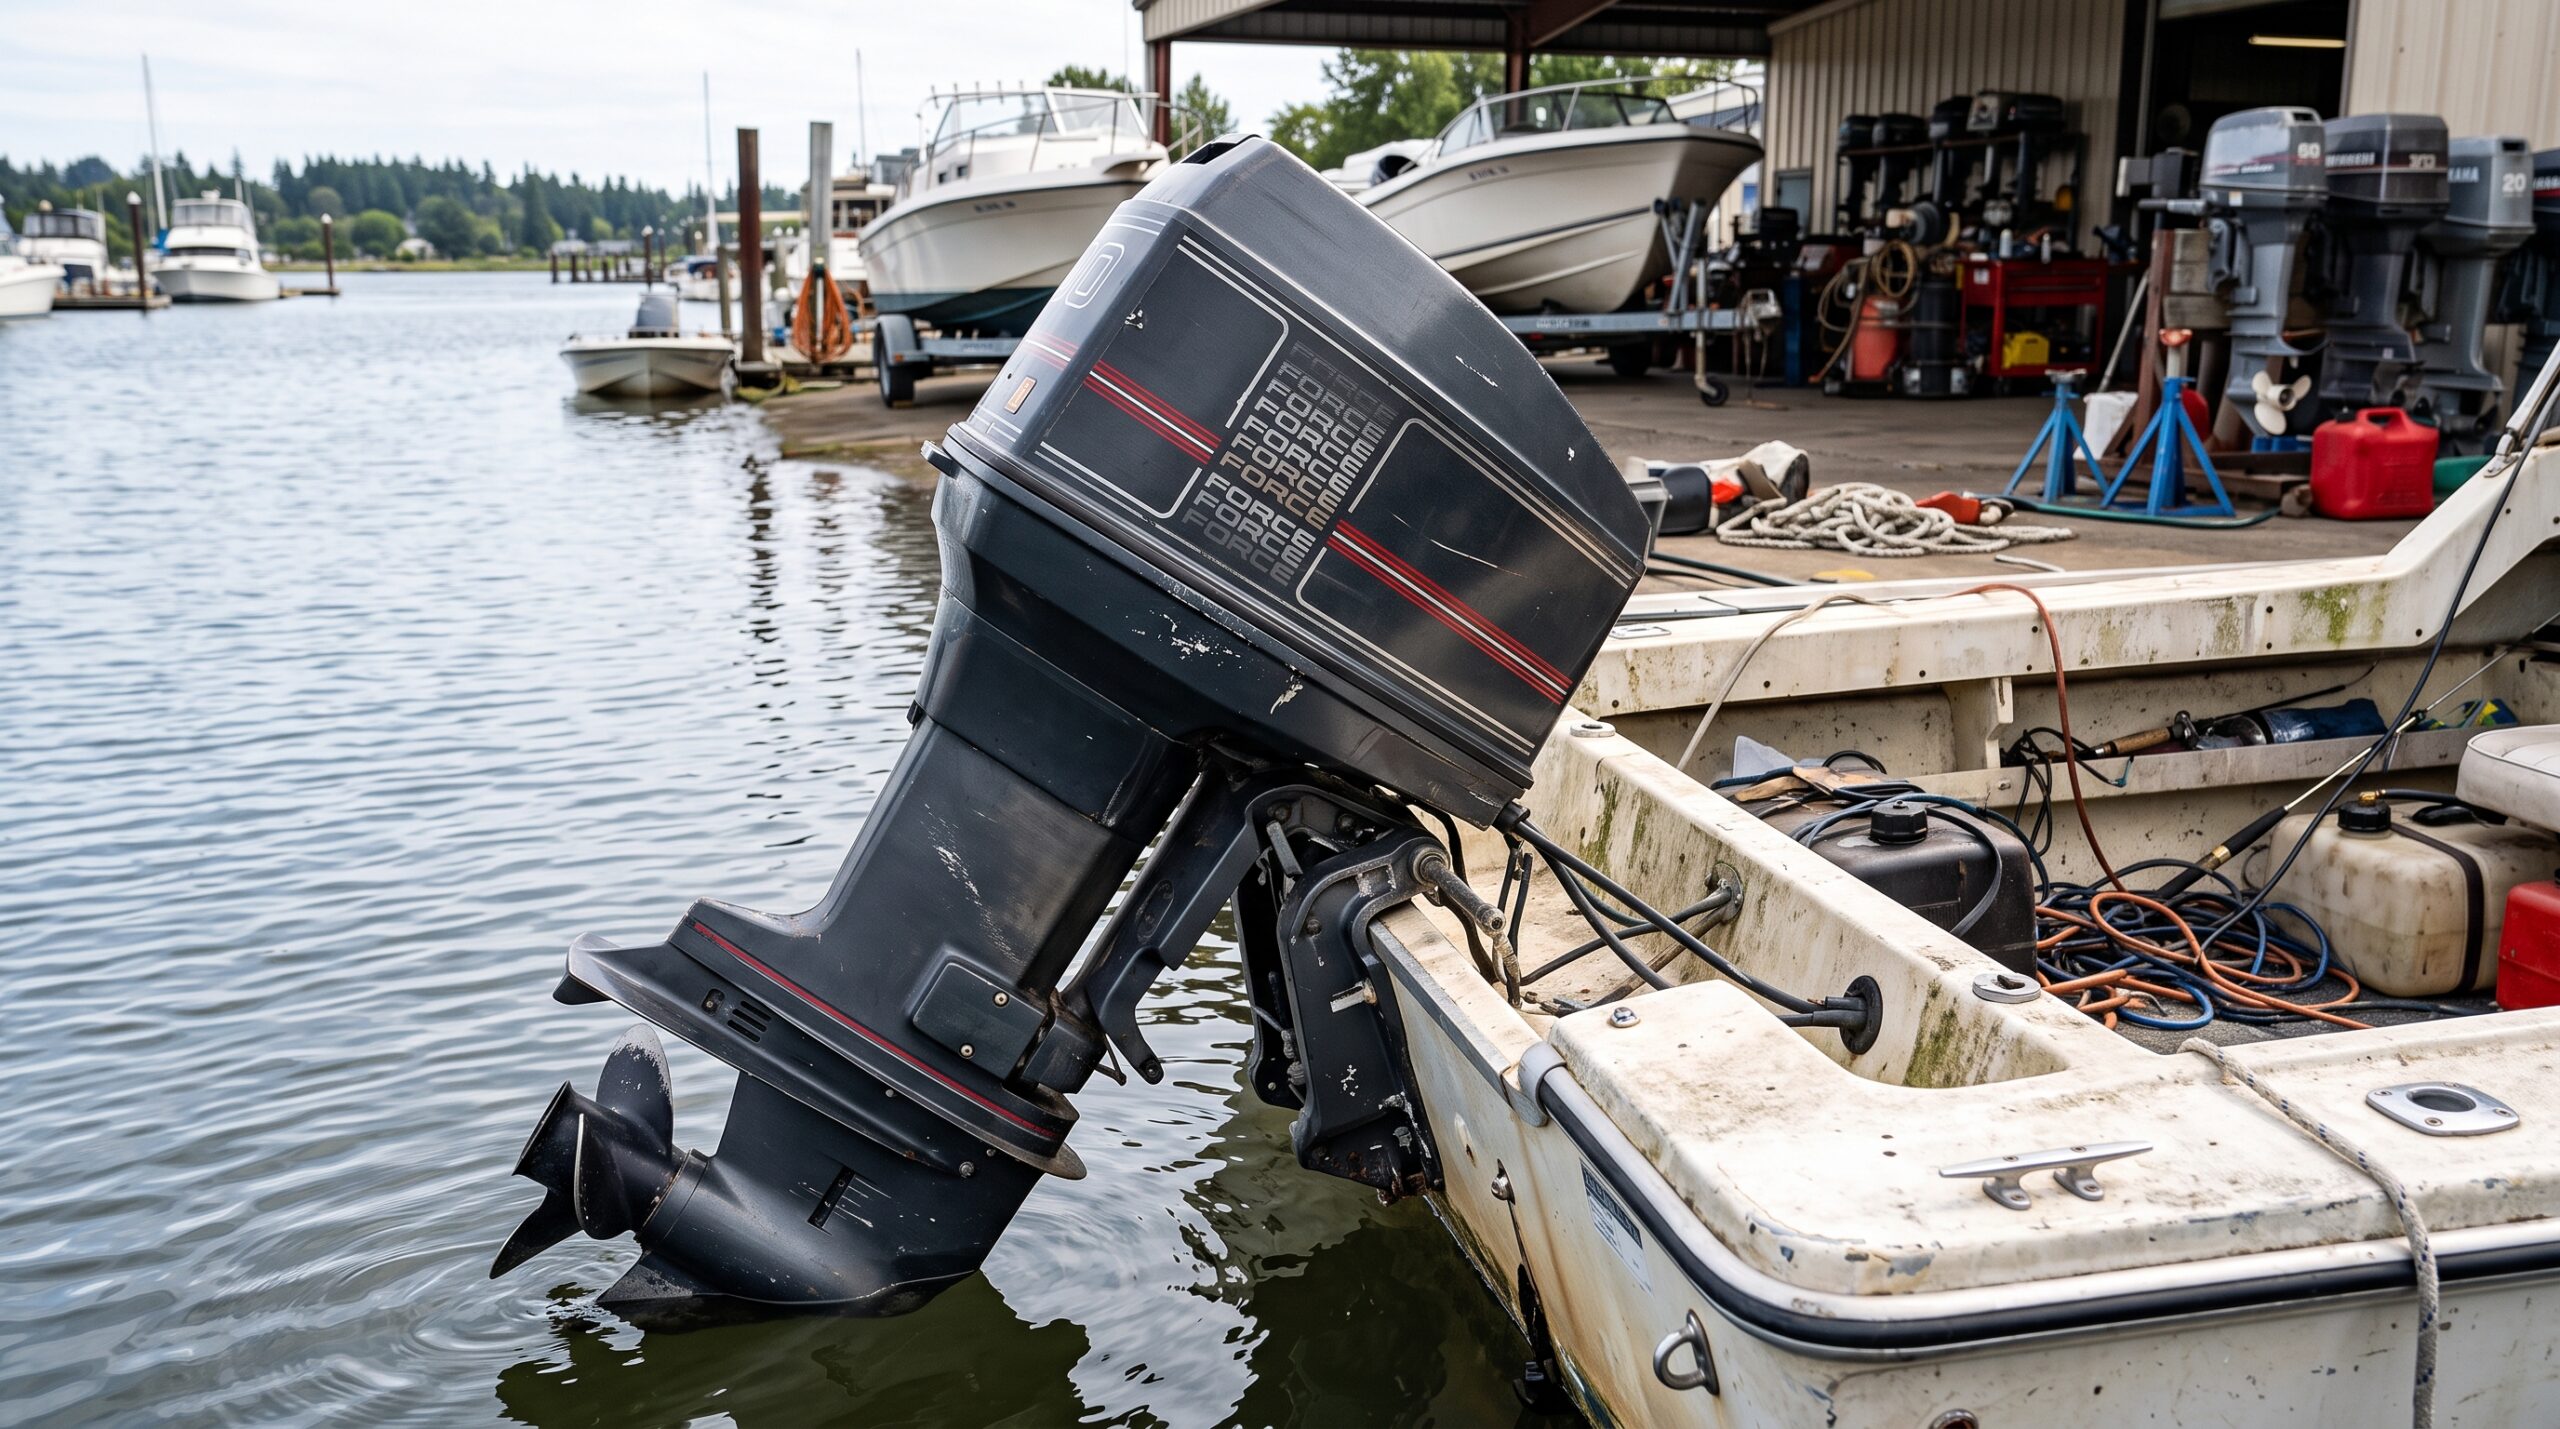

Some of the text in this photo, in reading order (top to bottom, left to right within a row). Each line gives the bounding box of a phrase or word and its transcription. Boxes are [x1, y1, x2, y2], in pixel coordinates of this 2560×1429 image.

[2502, 172, 2526, 193] 20
[1254, 395, 1363, 479] FORCE
[1265, 378, 1375, 461] FORCE
[1277, 360, 1387, 444] FORCE
[1219, 450, 1330, 531] FORCE
[1231, 432, 1342, 514] FORCE
[1242, 414, 1353, 496] FORCE
[1181, 507, 1294, 587] FORCE
[1193, 490, 1305, 569] FORCE
[1204, 472, 1316, 551] FORCE
